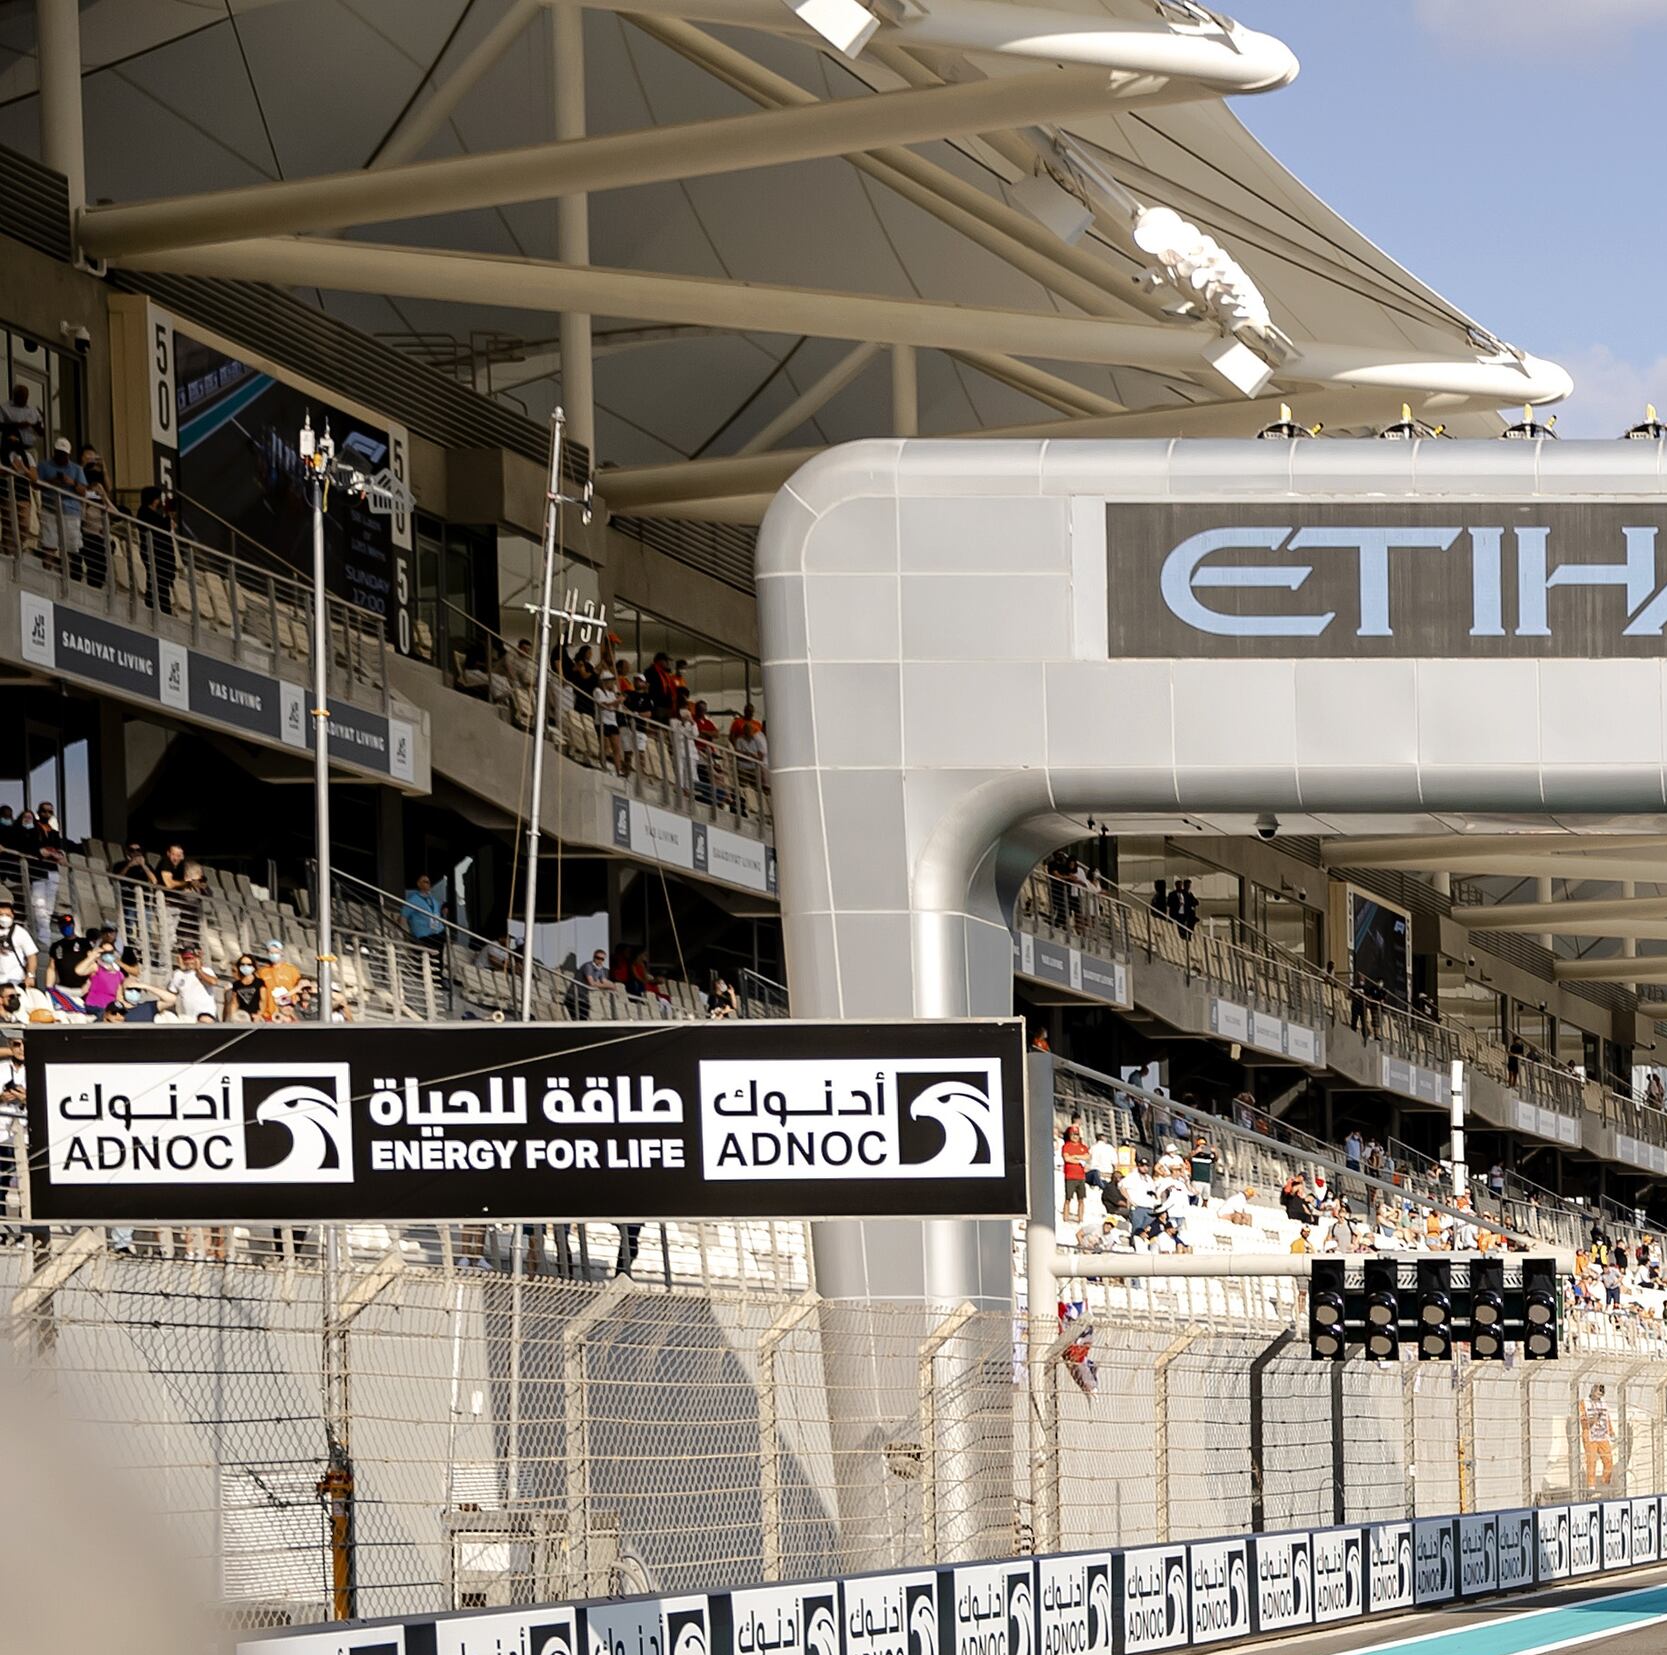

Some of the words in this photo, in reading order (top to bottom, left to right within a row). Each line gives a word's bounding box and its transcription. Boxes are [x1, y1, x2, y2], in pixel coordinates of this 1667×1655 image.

[62, 630, 116, 664] SAADIYAT
[117, 650, 153, 676] LIVING
[208, 680, 229, 702] YAS
[229, 687, 262, 712] LIVING
[356, 729, 385, 752] LIVING
[59, 1076, 231, 1131] أدنوك
[369, 1077, 527, 1136] للحياة
[542, 1076, 684, 1123] طاقة
[713, 1072, 885, 1127] أدنوك
[62, 1134, 234, 1170] ADNOC
[371, 1139, 518, 1170] ENERGY
[526, 1139, 600, 1169] FOR
[607, 1138, 685, 1168] LIFE
[717, 1130, 887, 1166] ADNOC
[958, 1574, 1006, 1632] أدنوك
[1043, 1566, 1087, 1620] أدنوك
[1262, 1589, 1292, 1621] ADNOC
[1318, 1582, 1345, 1613] ADNOC
[1372, 1575, 1397, 1603] ADNOC
[849, 1587, 905, 1648] أدنوك
[1128, 1608, 1164, 1642] ADNOC
[1196, 1599, 1229, 1632] ADNOC
